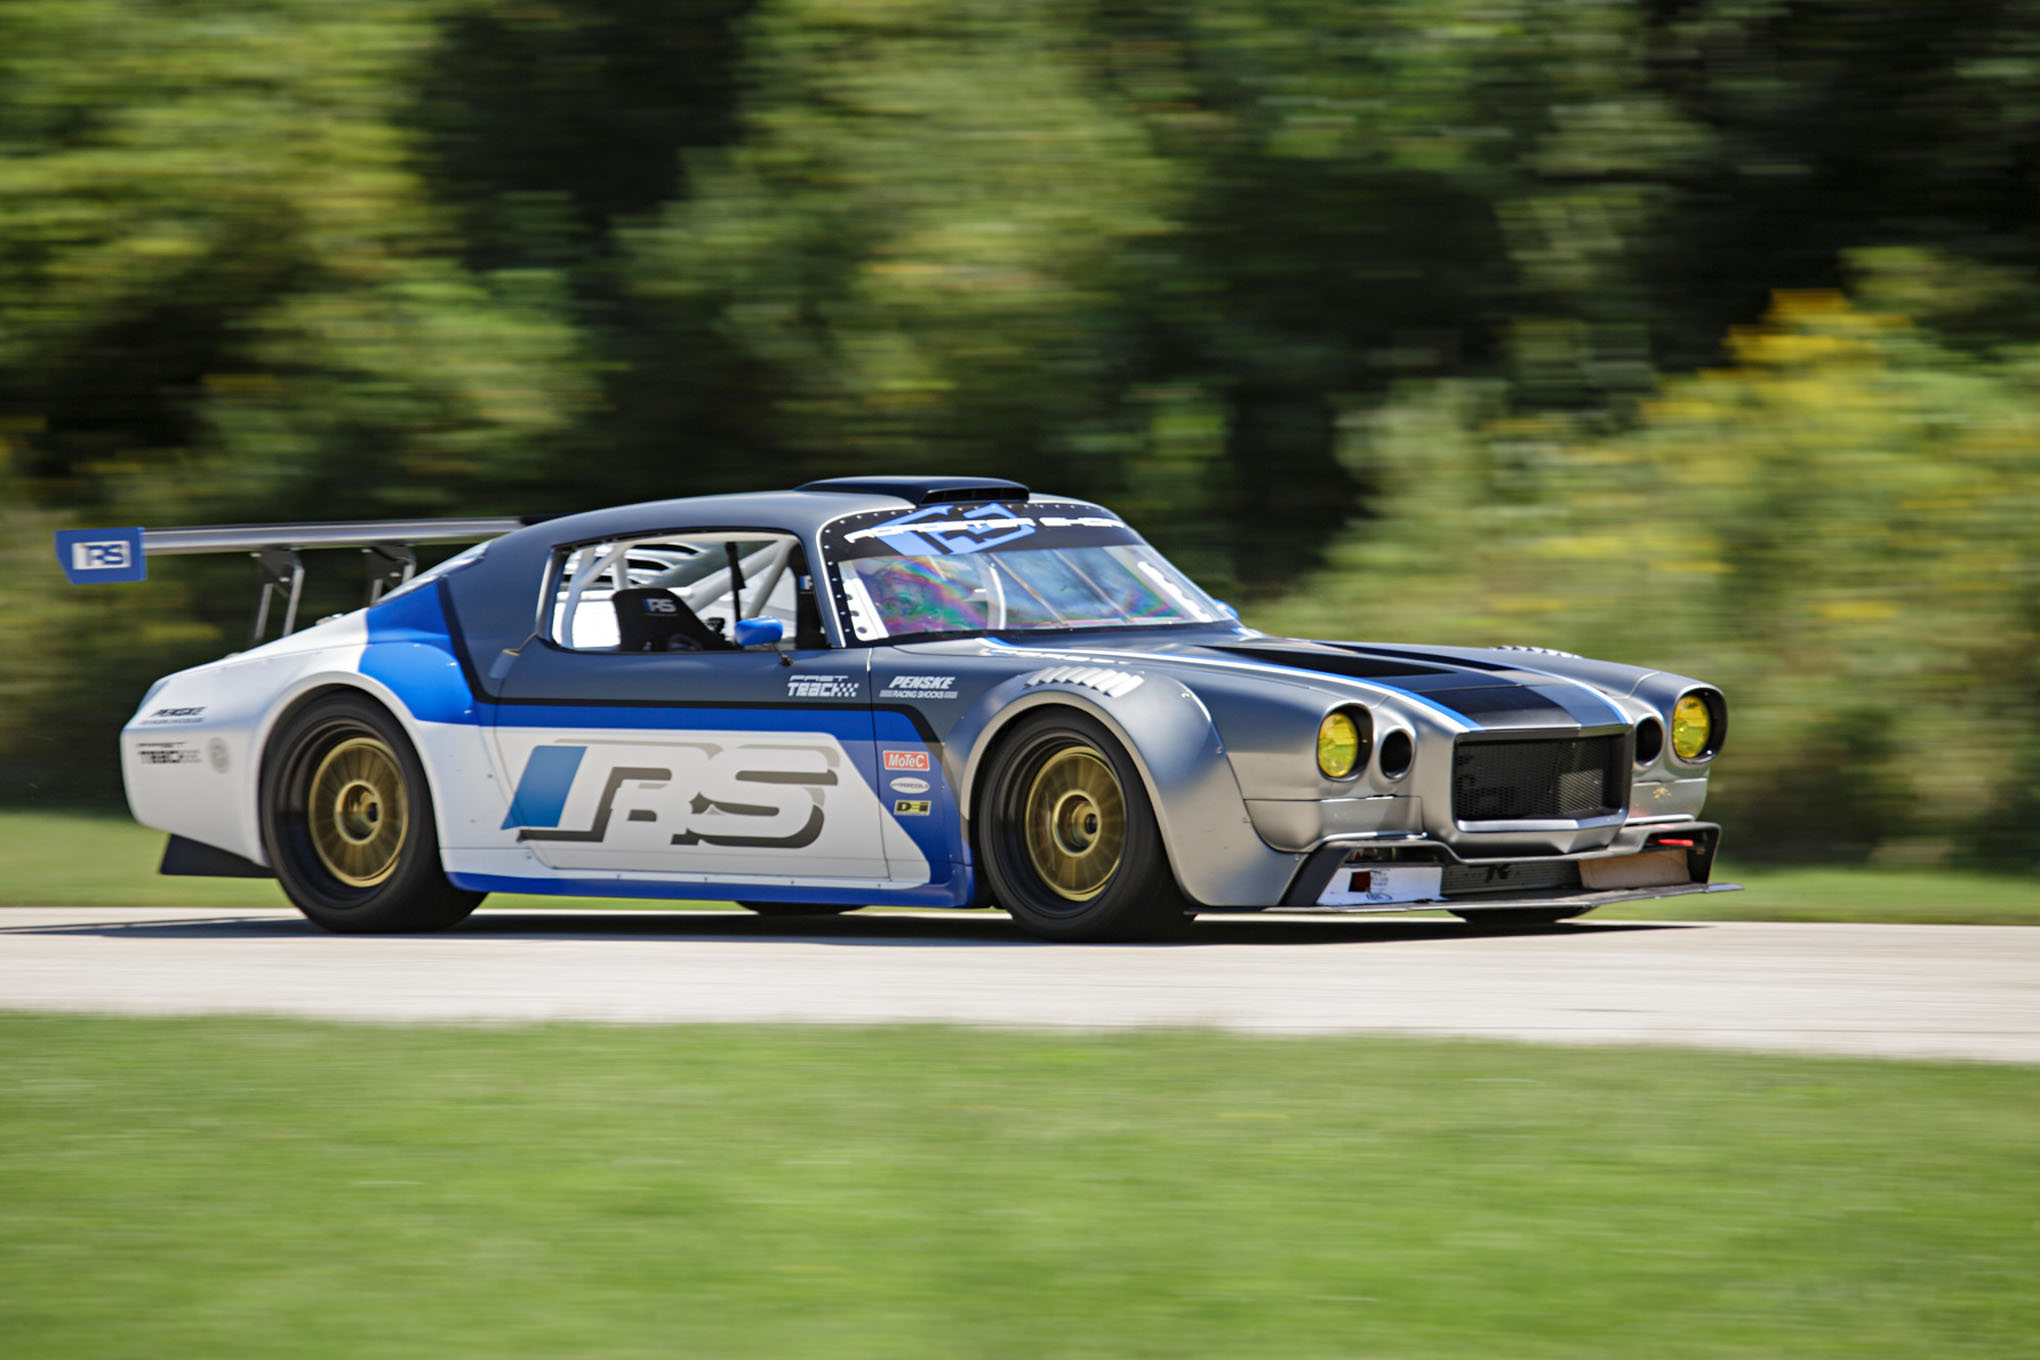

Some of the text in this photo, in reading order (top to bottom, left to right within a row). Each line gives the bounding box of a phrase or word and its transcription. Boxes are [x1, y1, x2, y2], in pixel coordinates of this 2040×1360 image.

[642, 598, 677, 612] RS
[888, 675, 956, 690] PENSKE
[893, 690, 944, 699] RACING SHOCKS
[888, 754, 925, 768] MoTeC
[500, 738, 840, 849] RS
